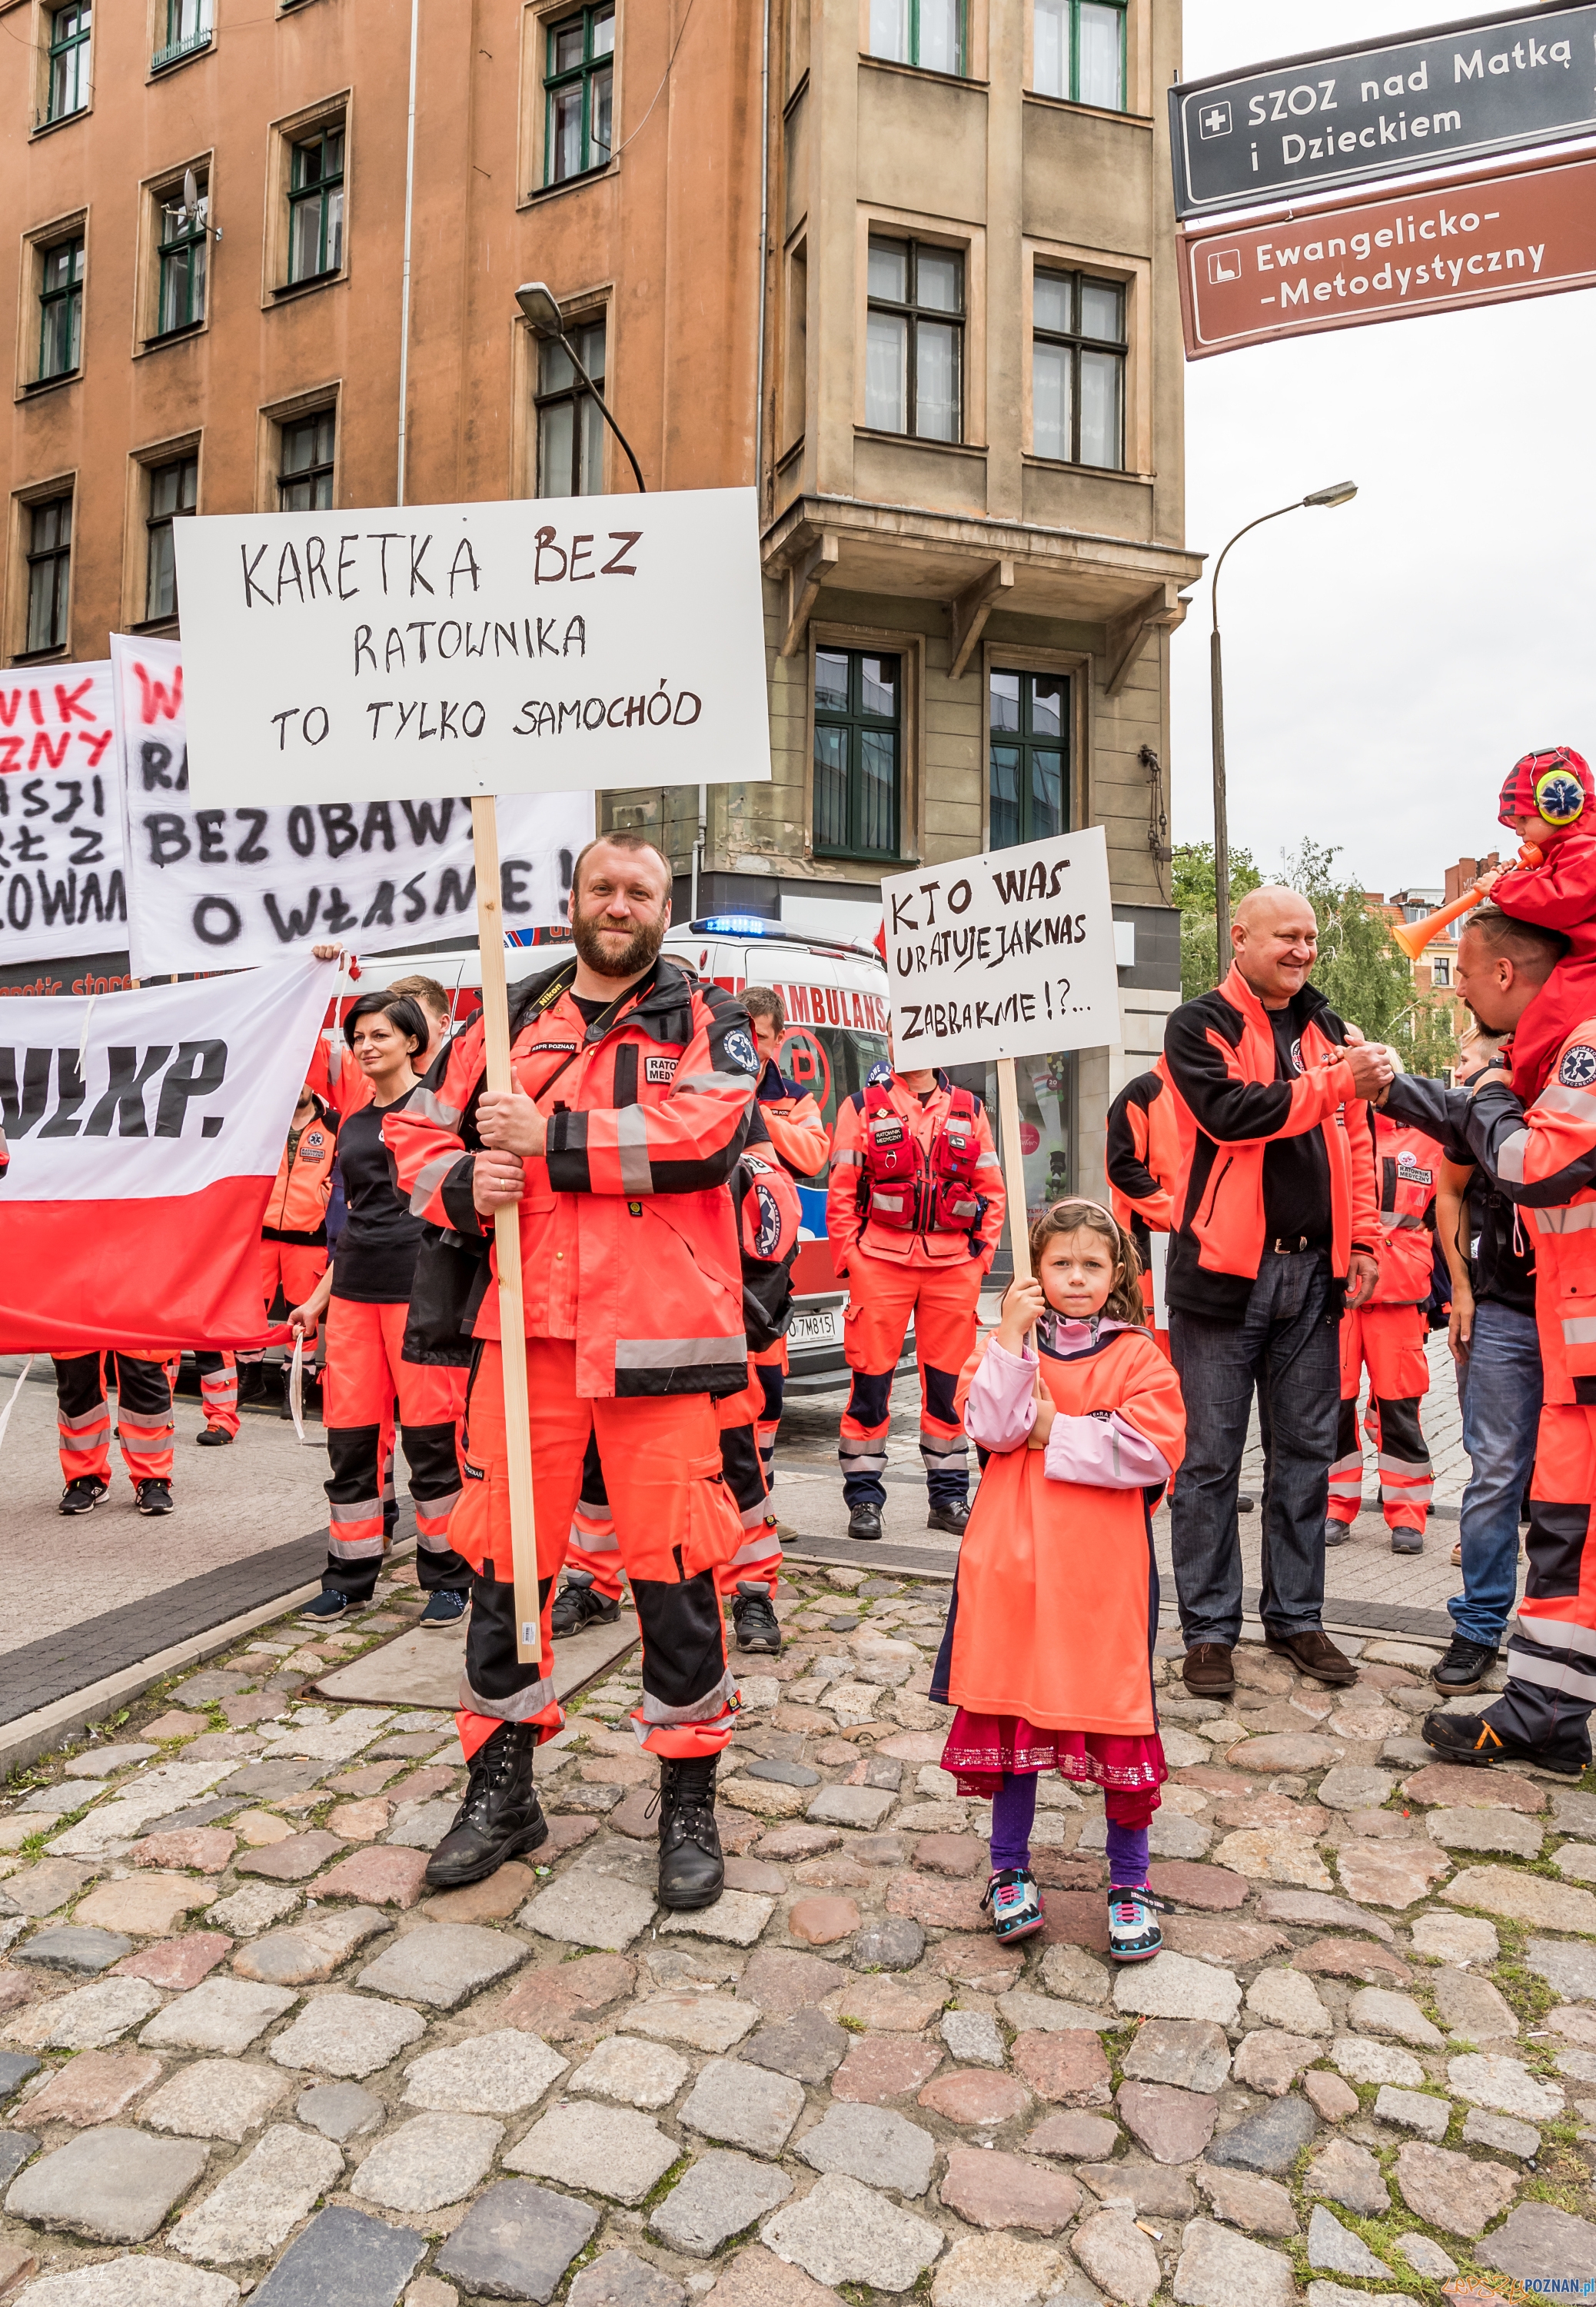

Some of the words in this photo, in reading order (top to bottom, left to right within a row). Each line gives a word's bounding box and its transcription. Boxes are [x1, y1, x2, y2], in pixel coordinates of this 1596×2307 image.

[1248, 79, 1338, 126] SZOZ
[1362, 62, 1428, 102] nad
[1455, 38, 1571, 84] Matką
[1251, 143, 1259, 171] i
[1282, 110, 1461, 165] Dzieckiem
[1256, 209, 1501, 272] Ewangelicko-
[1261, 243, 1546, 309] -Metodystyczny
[241, 532, 481, 608] KARETKA
[534, 525, 644, 584] BEZ
[354, 615, 586, 677] RATOWNIKA
[271, 706, 329, 751] TO
[366, 700, 487, 741] TYLKO
[513, 677, 701, 736] SAMOCHÓD
[143, 809, 269, 869] BEZ
[192, 895, 241, 945] O
[891, 879, 973, 935] KTO
[992, 859, 1071, 905] WAS
[539, 983, 563, 1007] Nikon
[771, 984, 895, 1033] AMBULANS
[650, 1060, 678, 1070] RATO
[876, 1128, 901, 1138] RATOWNIK
[876, 1134, 902, 1144] MEDYCZNY
[1399, 1166, 1429, 1177] RATOWNIK
[1399, 1171, 1430, 1183] MEDYCZNY
[799, 1316, 832, 1337] 7M815
